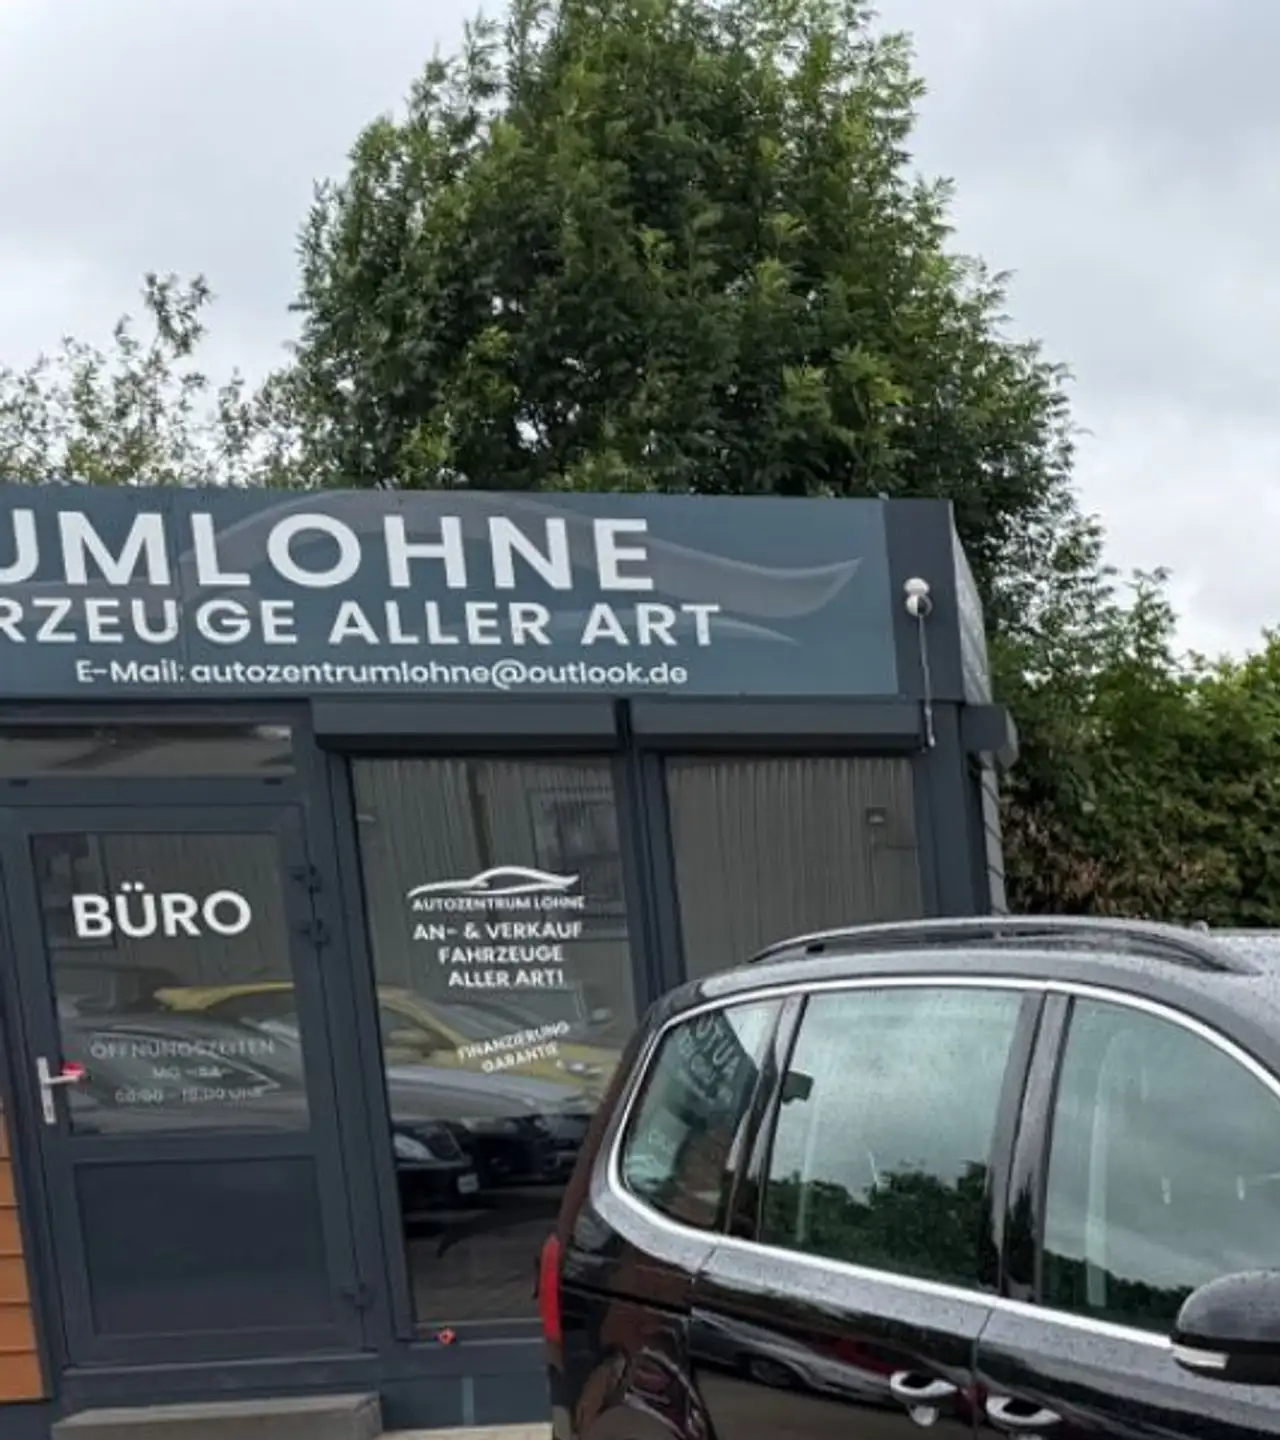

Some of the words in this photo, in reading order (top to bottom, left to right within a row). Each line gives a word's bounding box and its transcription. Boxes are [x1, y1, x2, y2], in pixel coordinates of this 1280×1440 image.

[328, 598, 552, 646] ALLER
[580, 602, 721, 647] ART
[76, 658, 184, 685] E-Mail:
[190, 657, 689, 691] autozentrumlohne@outlook.de
[72, 881, 252, 937] BÜRO
[412, 896, 531, 912] AUTOZENTRUM
[413, 923, 458, 940] AN-
[464, 921, 481, 940] &
[484, 921, 583, 940] VERKAUF
[437, 945, 564, 964] FAHRZEUGE
[449, 969, 510, 987] ALLER
[457, 1019, 570, 1063] FINANZIERUNG
[481, 1042, 559, 1073] GARANTIE
